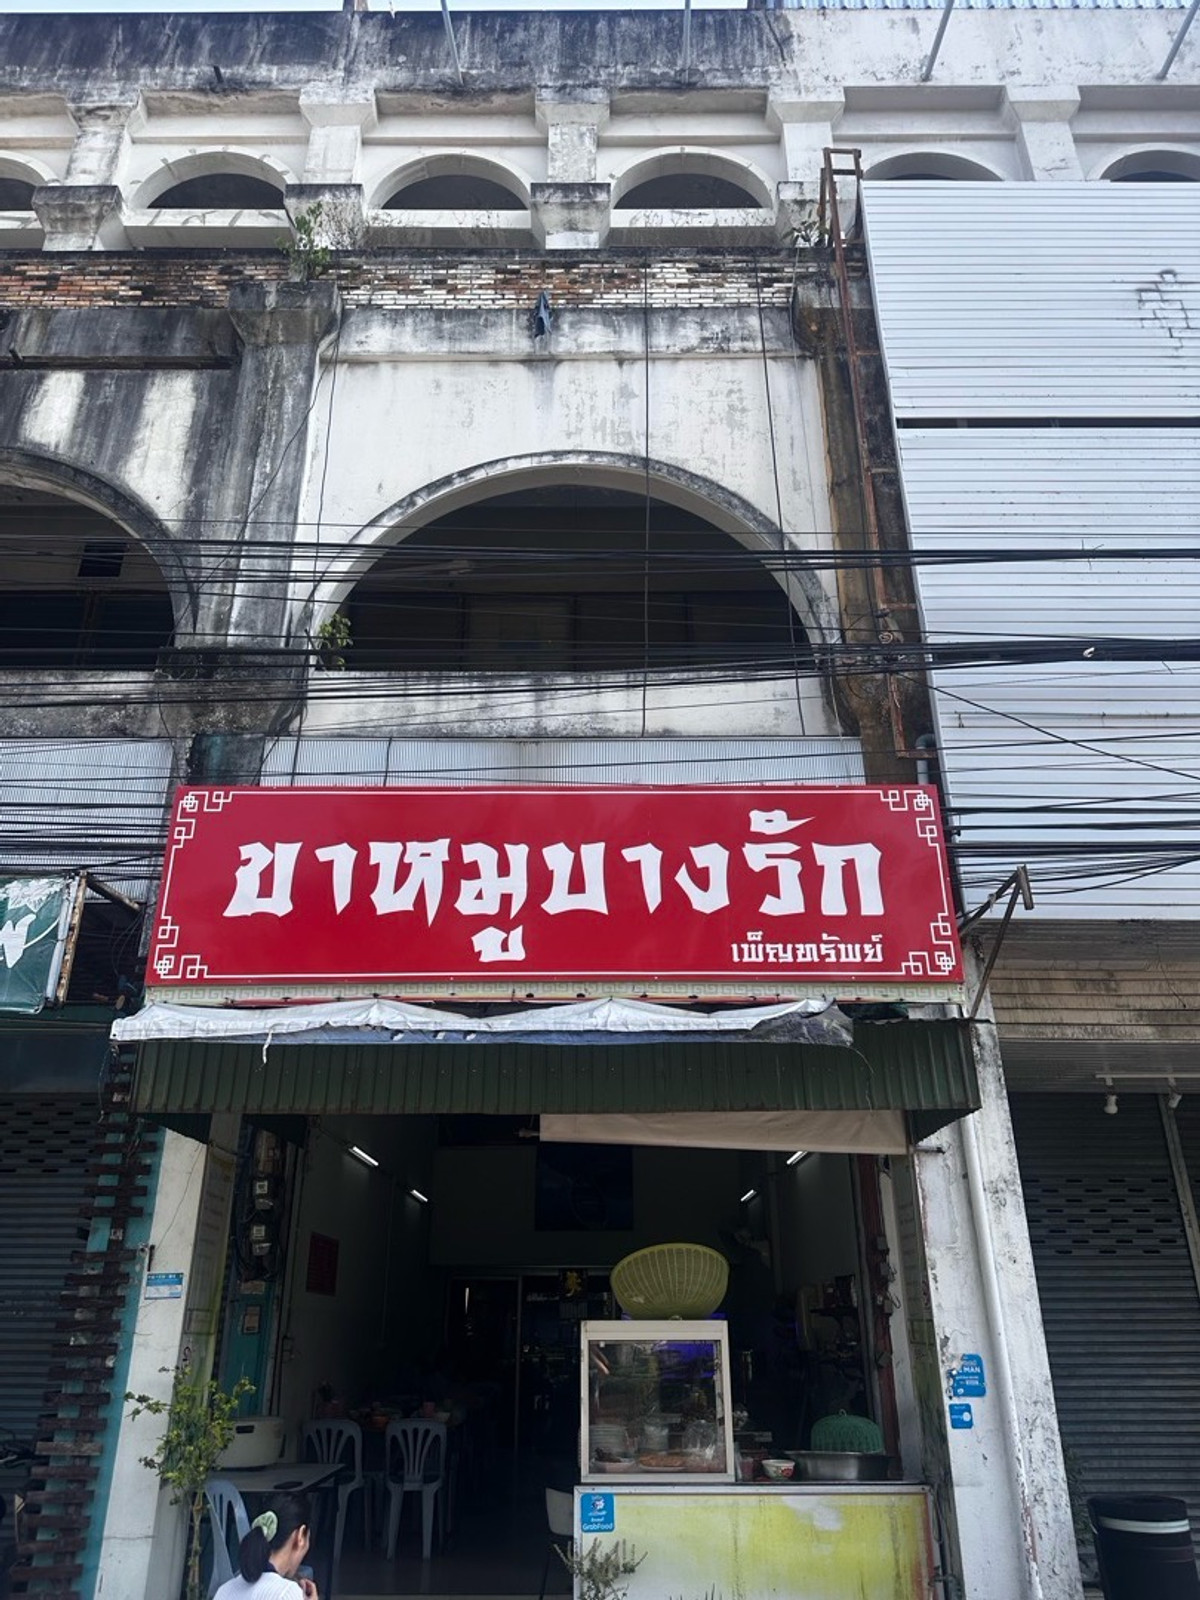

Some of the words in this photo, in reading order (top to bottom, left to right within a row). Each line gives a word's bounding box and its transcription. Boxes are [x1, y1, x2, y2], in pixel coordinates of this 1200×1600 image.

[223, 809, 884, 963] ขาหมูบางรัก
[731, 931, 884, 964] เพ็ญทรัพย์
[582, 1523, 613, 1531] GrabFood
